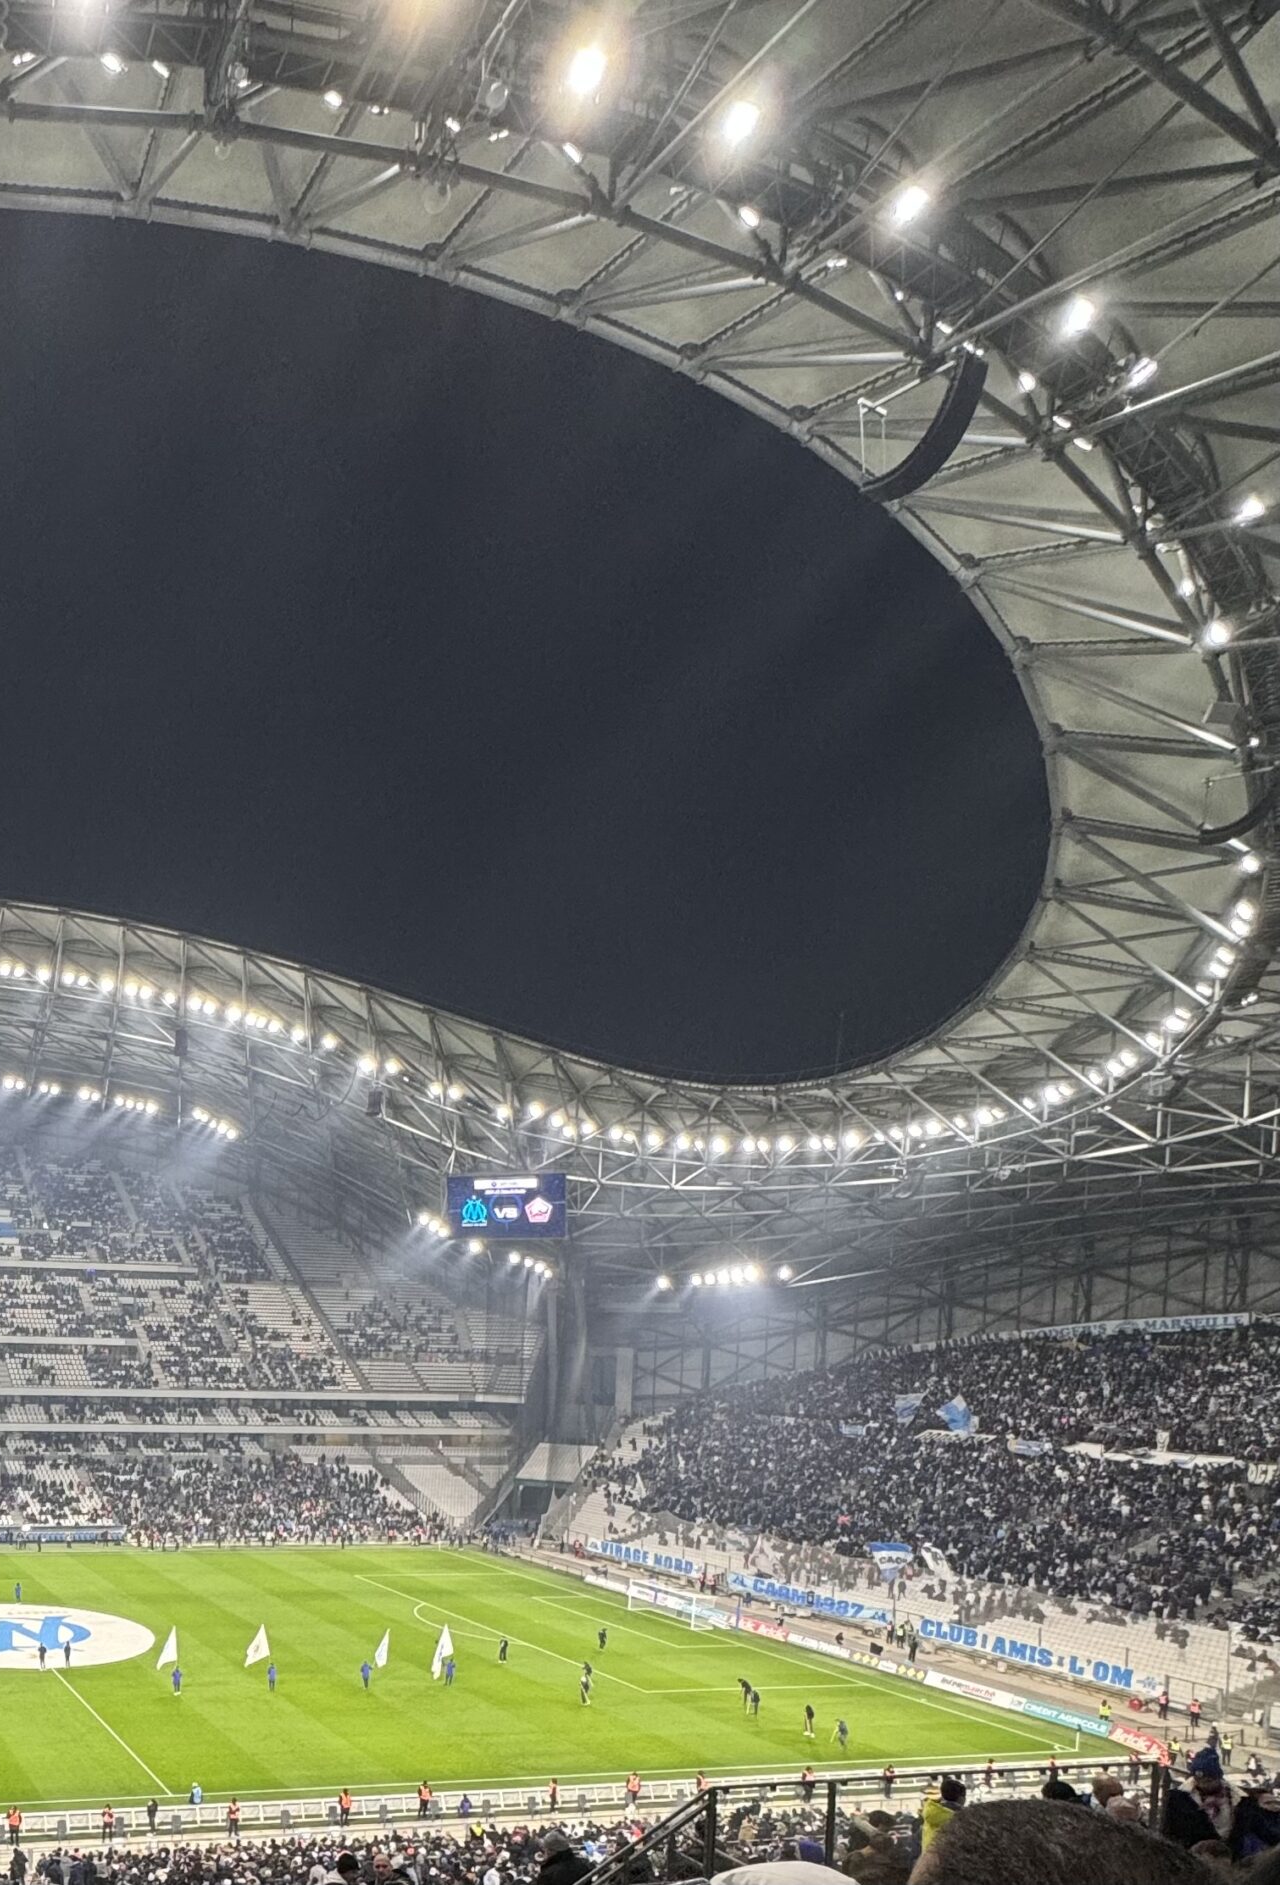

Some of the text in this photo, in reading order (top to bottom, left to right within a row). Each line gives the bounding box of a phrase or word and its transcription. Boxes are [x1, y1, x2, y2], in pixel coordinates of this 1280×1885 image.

[1143, 1315, 1244, 1331] MARSEILLE
[600, 1541, 694, 1574] VIRAGE NORD
[814, 1593, 865, 1617] 1987
[920, 1618, 979, 1647] CLUB
[991, 1636, 1053, 1667] AMIS
[1069, 1655, 1135, 1688] L'OM
[1058, 1712, 1108, 1733] AGRICOLE
